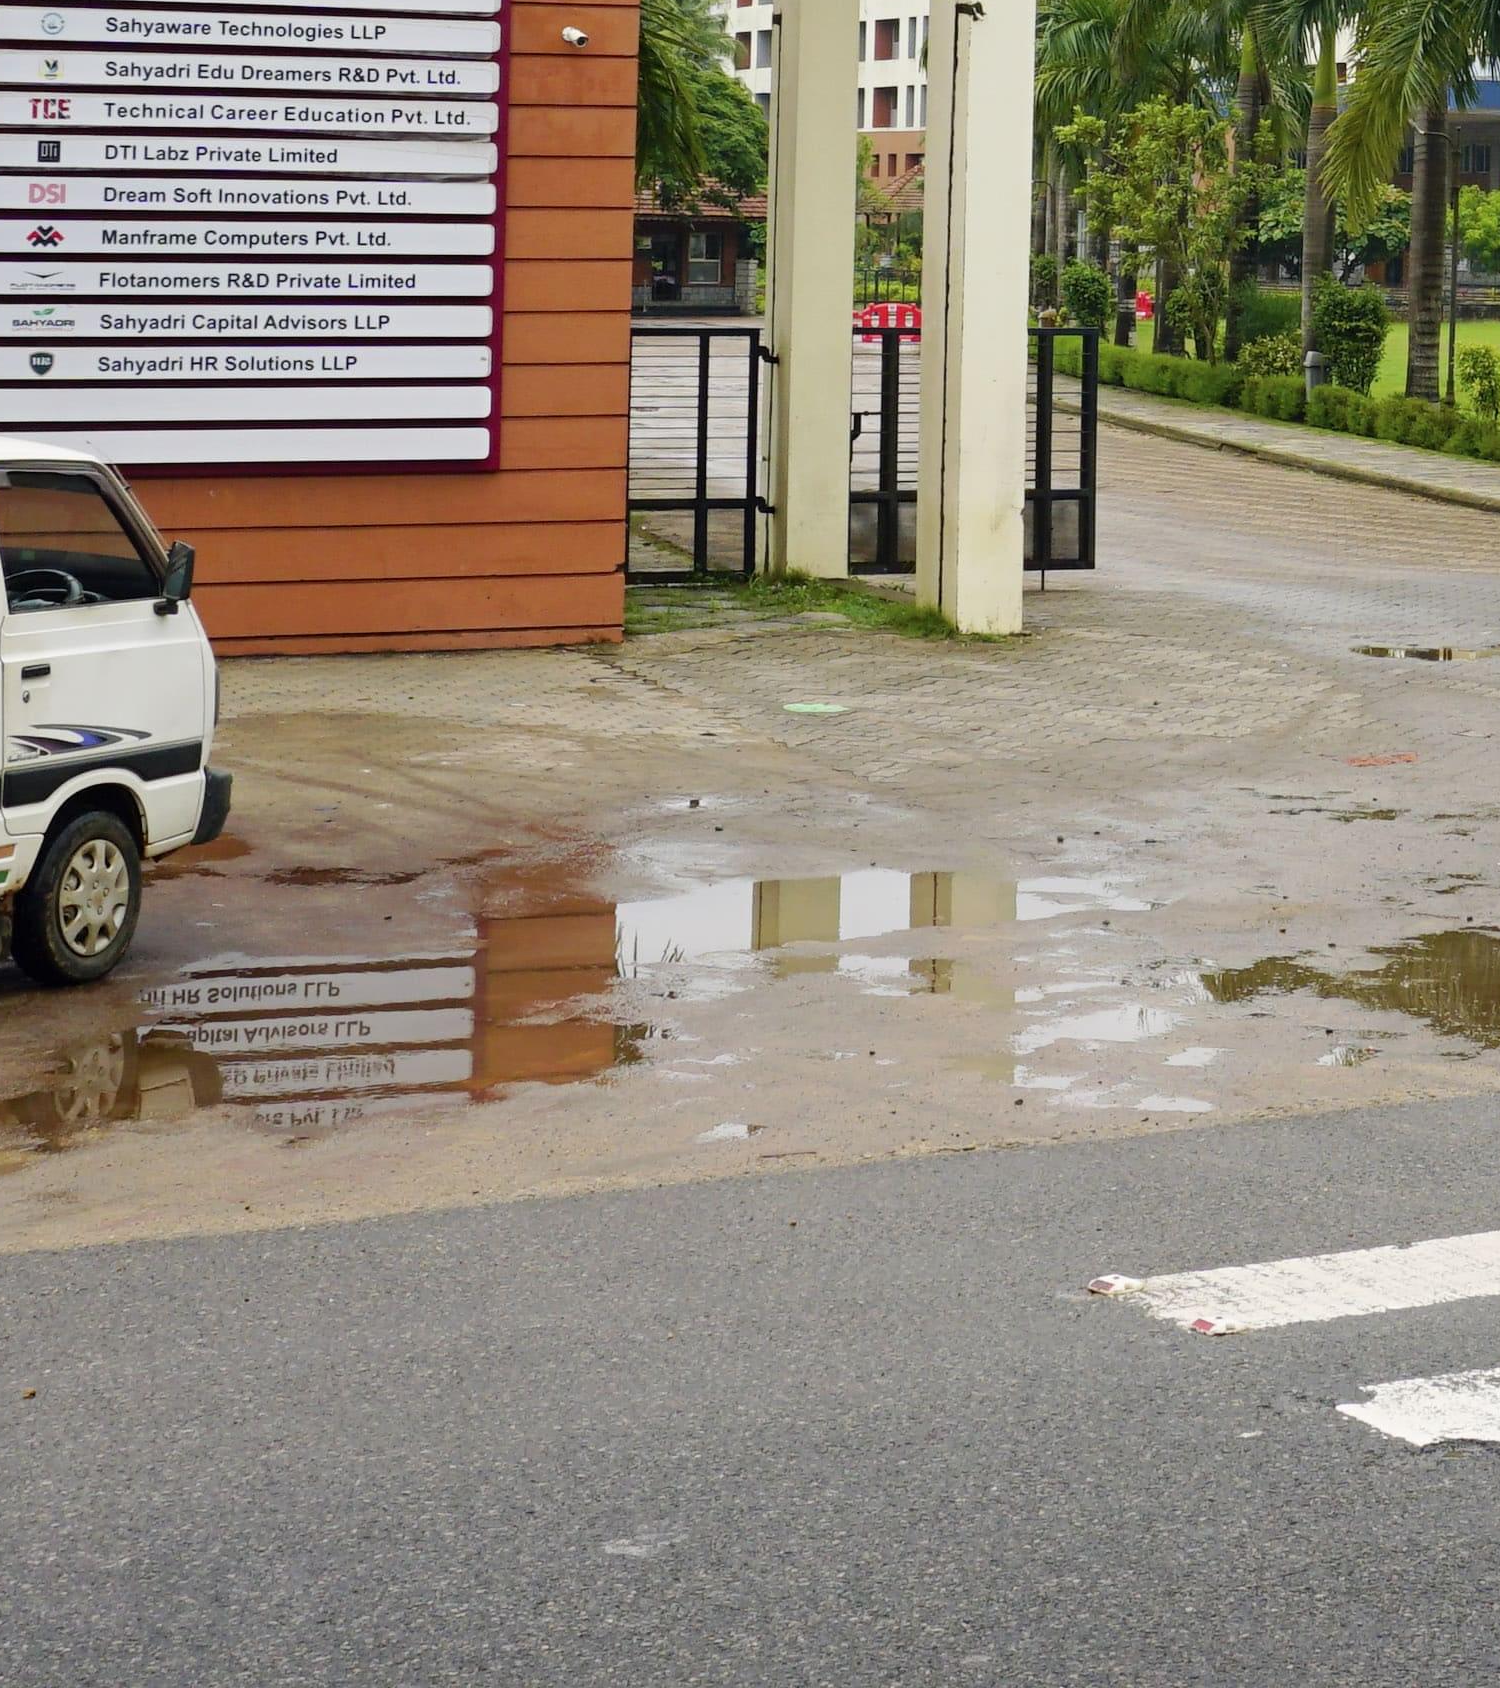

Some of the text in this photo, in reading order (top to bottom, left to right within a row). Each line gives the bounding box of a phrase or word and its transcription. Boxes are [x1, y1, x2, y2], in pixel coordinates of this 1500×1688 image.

[106, 17, 386, 42] Sahyaware Technologies LLP
[105, 61, 462, 86] Sahyadri Edu Dreamers R&D Pvt. Ltd.
[29, 98, 71, 119] TCE
[104, 103, 471, 126] Technical Career Education Pvt. Ltd.
[105, 145, 338, 164] DTI Labz Private Limited
[28, 183, 66, 204] DSI
[103, 187, 412, 207] Dream Soft Innovations Pvt. Ltd.
[101, 229, 391, 250] Manframe Computers Pvt. Ltd.
[99, 272, 416, 290] Flotanomers R&D Private Limited
[100, 313, 391, 334] Sahyadri Capital Advisors LLP
[97, 355, 358, 375] Sahyadri HR Solutions LLP
